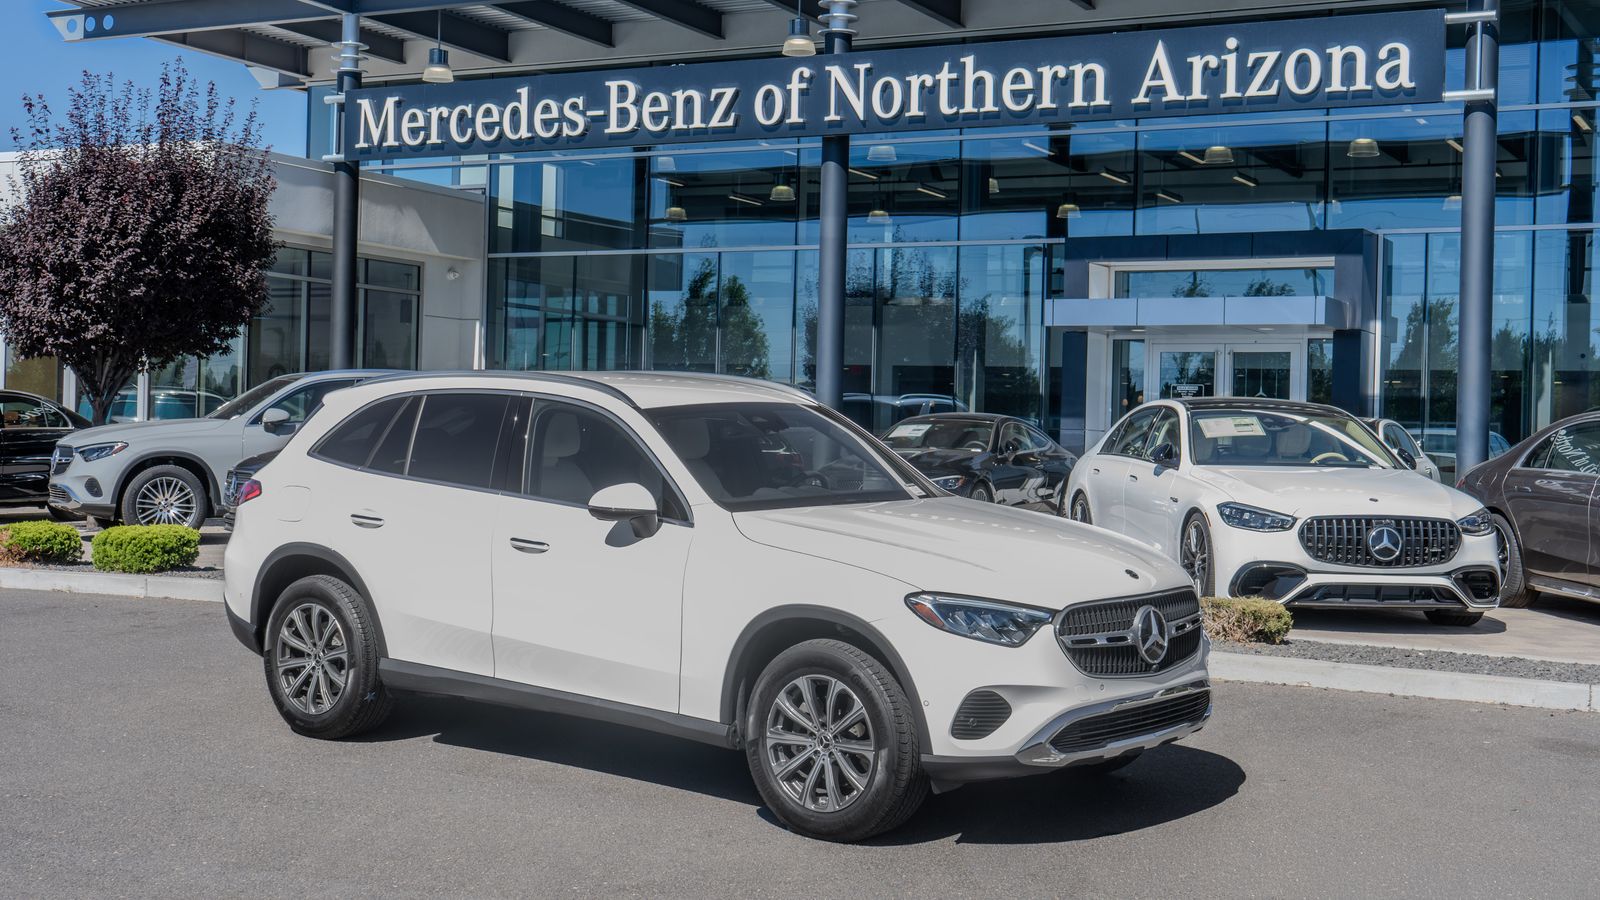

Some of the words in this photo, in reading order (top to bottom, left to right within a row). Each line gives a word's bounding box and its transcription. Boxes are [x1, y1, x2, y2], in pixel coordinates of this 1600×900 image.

[355, 79, 738, 149] Mercedes-Benz
[754, 66, 812, 126] of
[824, 54, 1111, 122] Northern
[1131, 37, 1416, 105] Arizona
